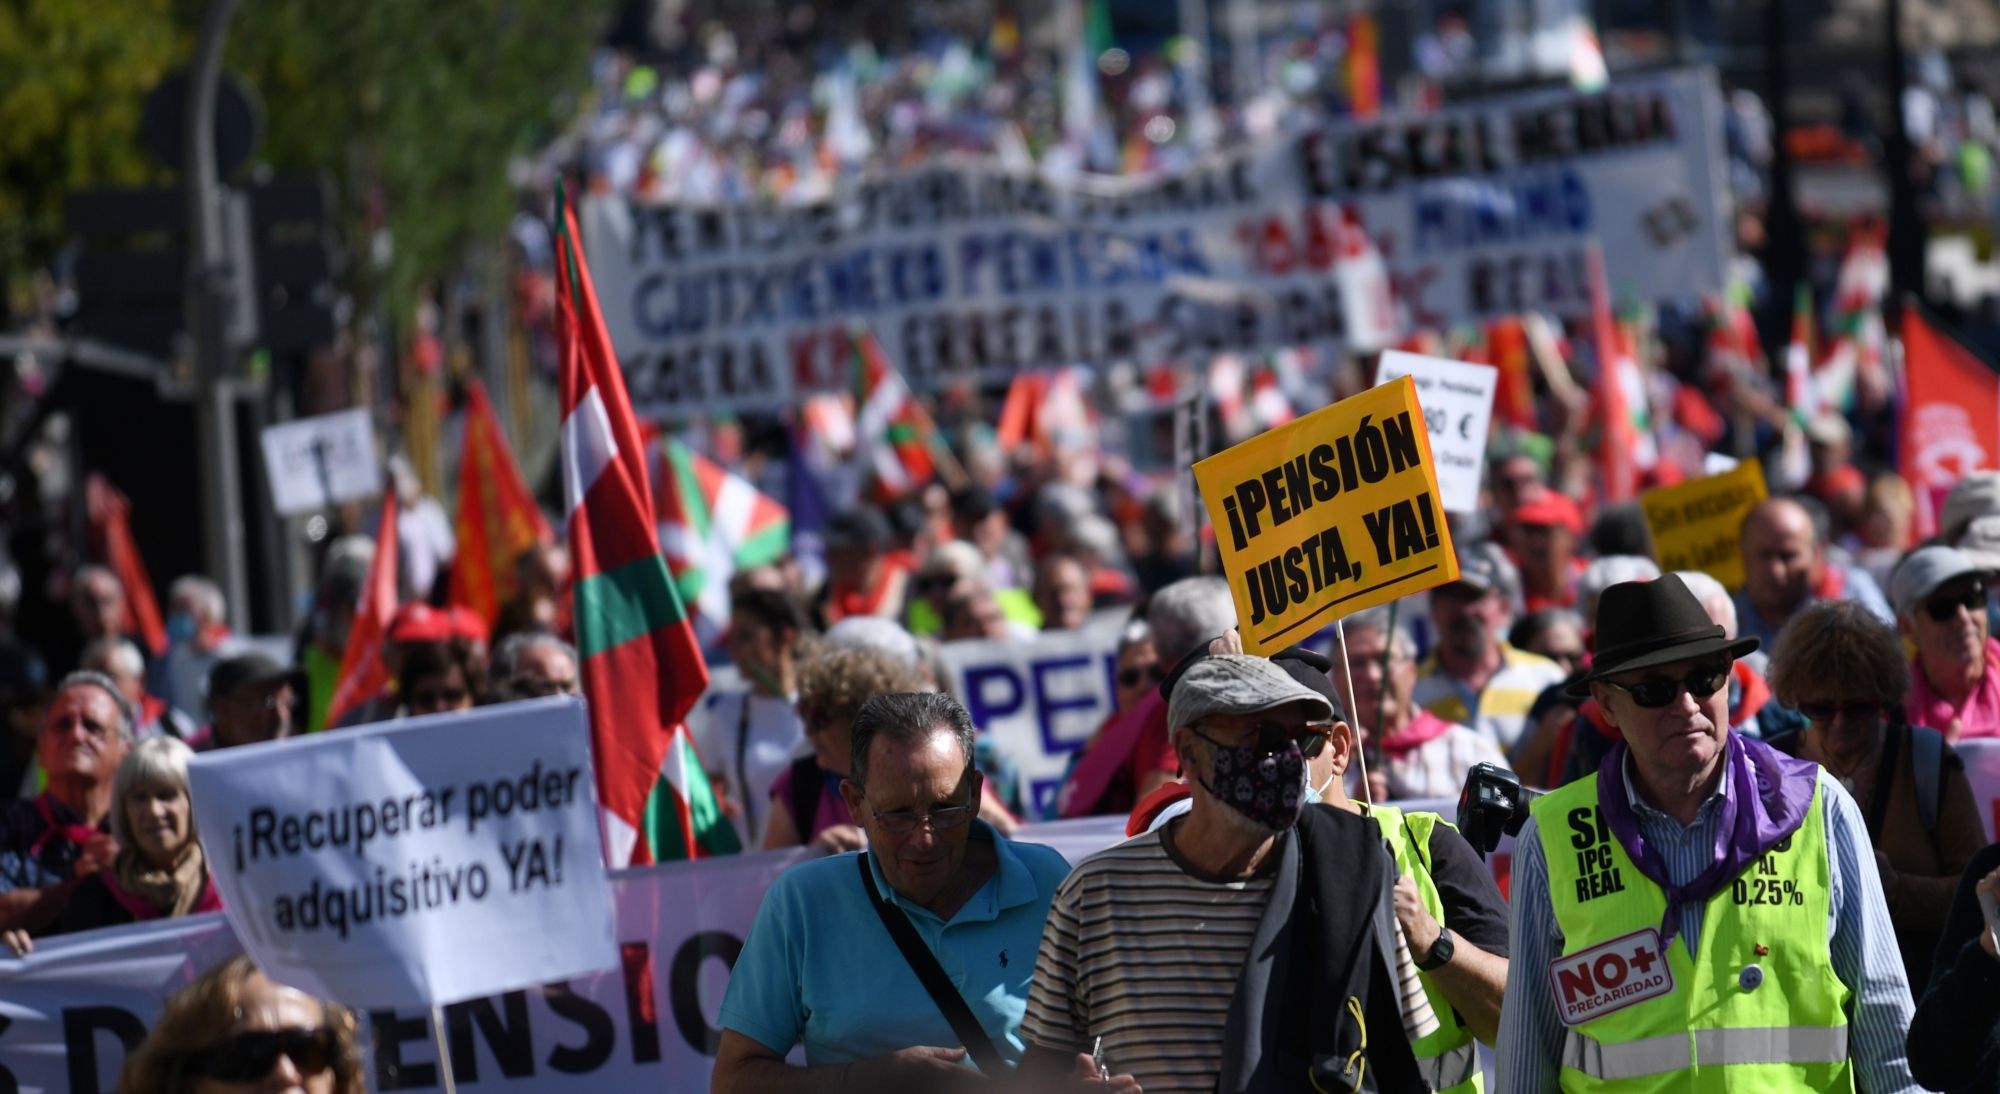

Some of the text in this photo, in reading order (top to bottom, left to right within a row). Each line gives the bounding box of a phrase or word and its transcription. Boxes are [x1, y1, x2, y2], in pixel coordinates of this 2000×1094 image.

[1222, 410, 1421, 552] ¡PENSIÓN
[1245, 491, 1440, 626] JUSTA, YA!
[964, 652, 1120, 758] PE
[233, 760, 582, 875] ¡Recuperar poder
[1577, 844, 1613, 876] IPC
[1758, 855, 1778, 876] AL
[273, 834, 566, 940] adquisitivo YA!
[1575, 867, 1625, 904] REAL
[1732, 878, 1804, 907] 0,25%
[370, 930, 747, 1091] ENSIO
[1567, 974, 1664, 1017] PRECARIEDAD
